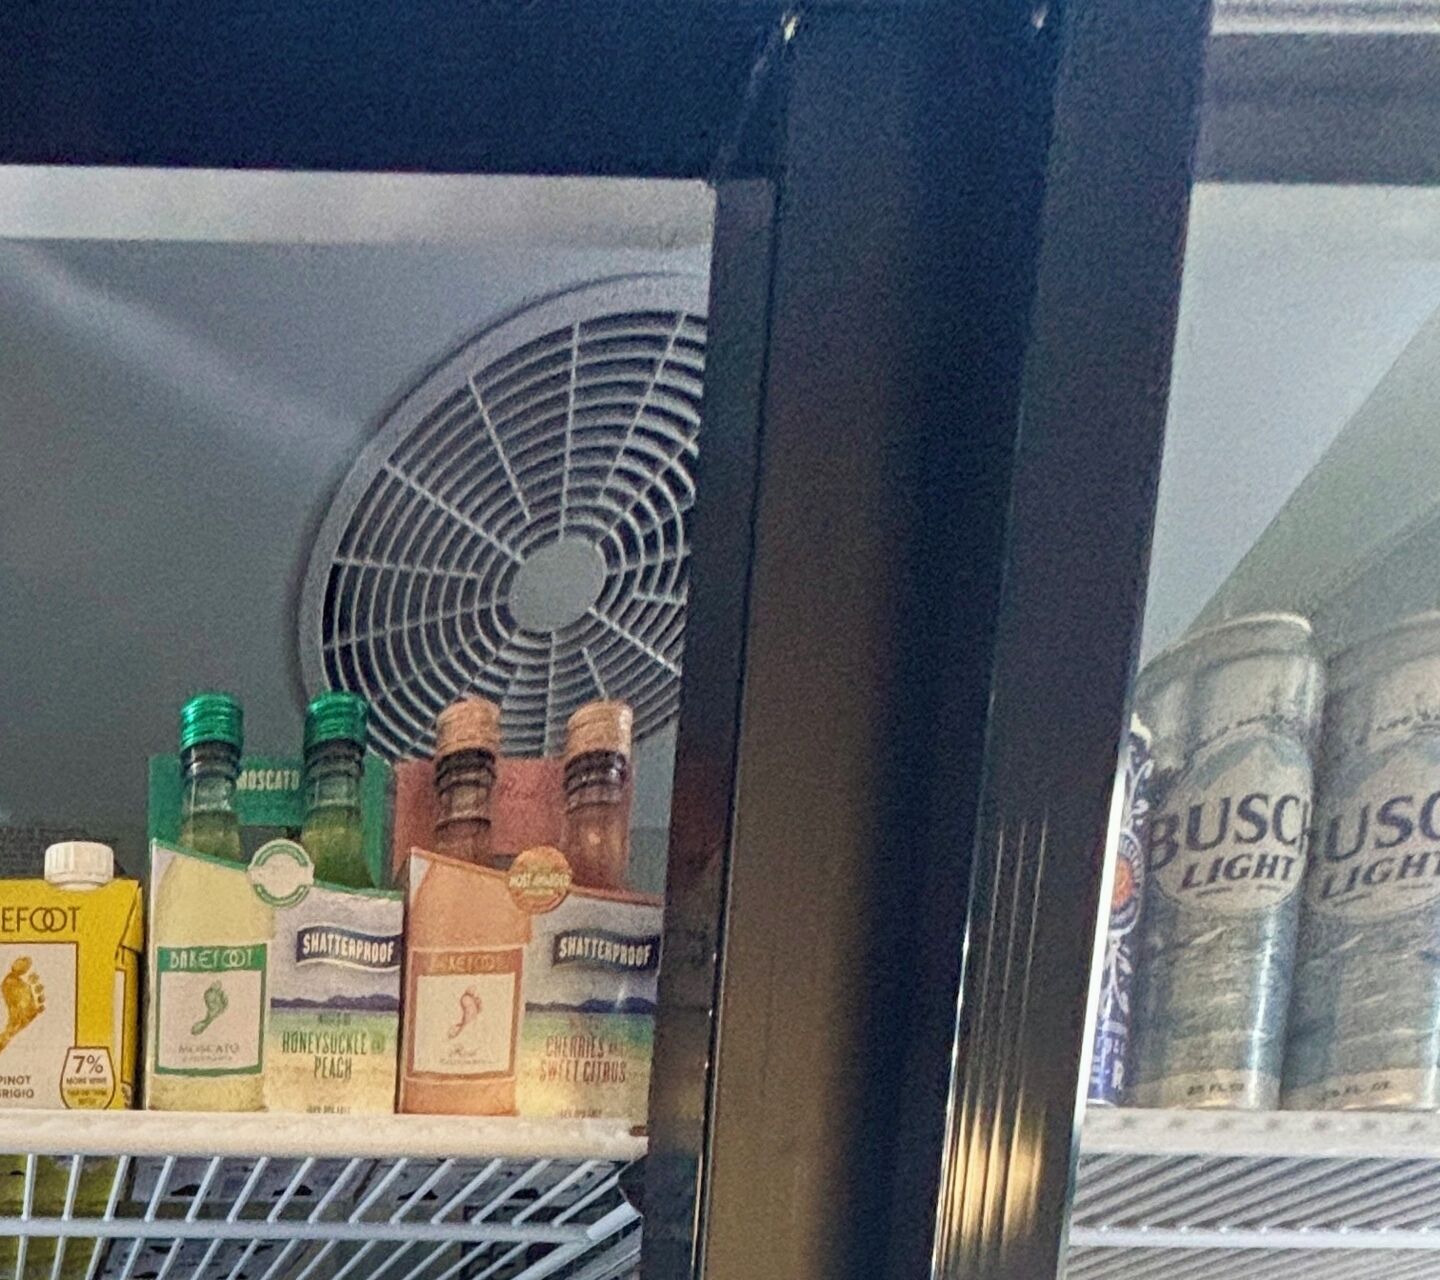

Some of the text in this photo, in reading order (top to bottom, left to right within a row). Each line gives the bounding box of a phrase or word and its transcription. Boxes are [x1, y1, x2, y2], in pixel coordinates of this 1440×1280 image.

[1182, 853, 1297, 890] LIGHT
[168, 949, 252, 968] BAREFOOT
[302, 931, 395, 963] SHATTERPROOF
[559, 935, 652, 966] SHATTERPROOF
[281, 1031, 367, 1055] HONEYSUCKLE
[545, 1034, 606, 1057] CHERRIES
[72, 1055, 104, 1074] 7%
[314, 1058, 352, 1080] PEACH
[539, 1061, 627, 1084] SWEET CITRUS
